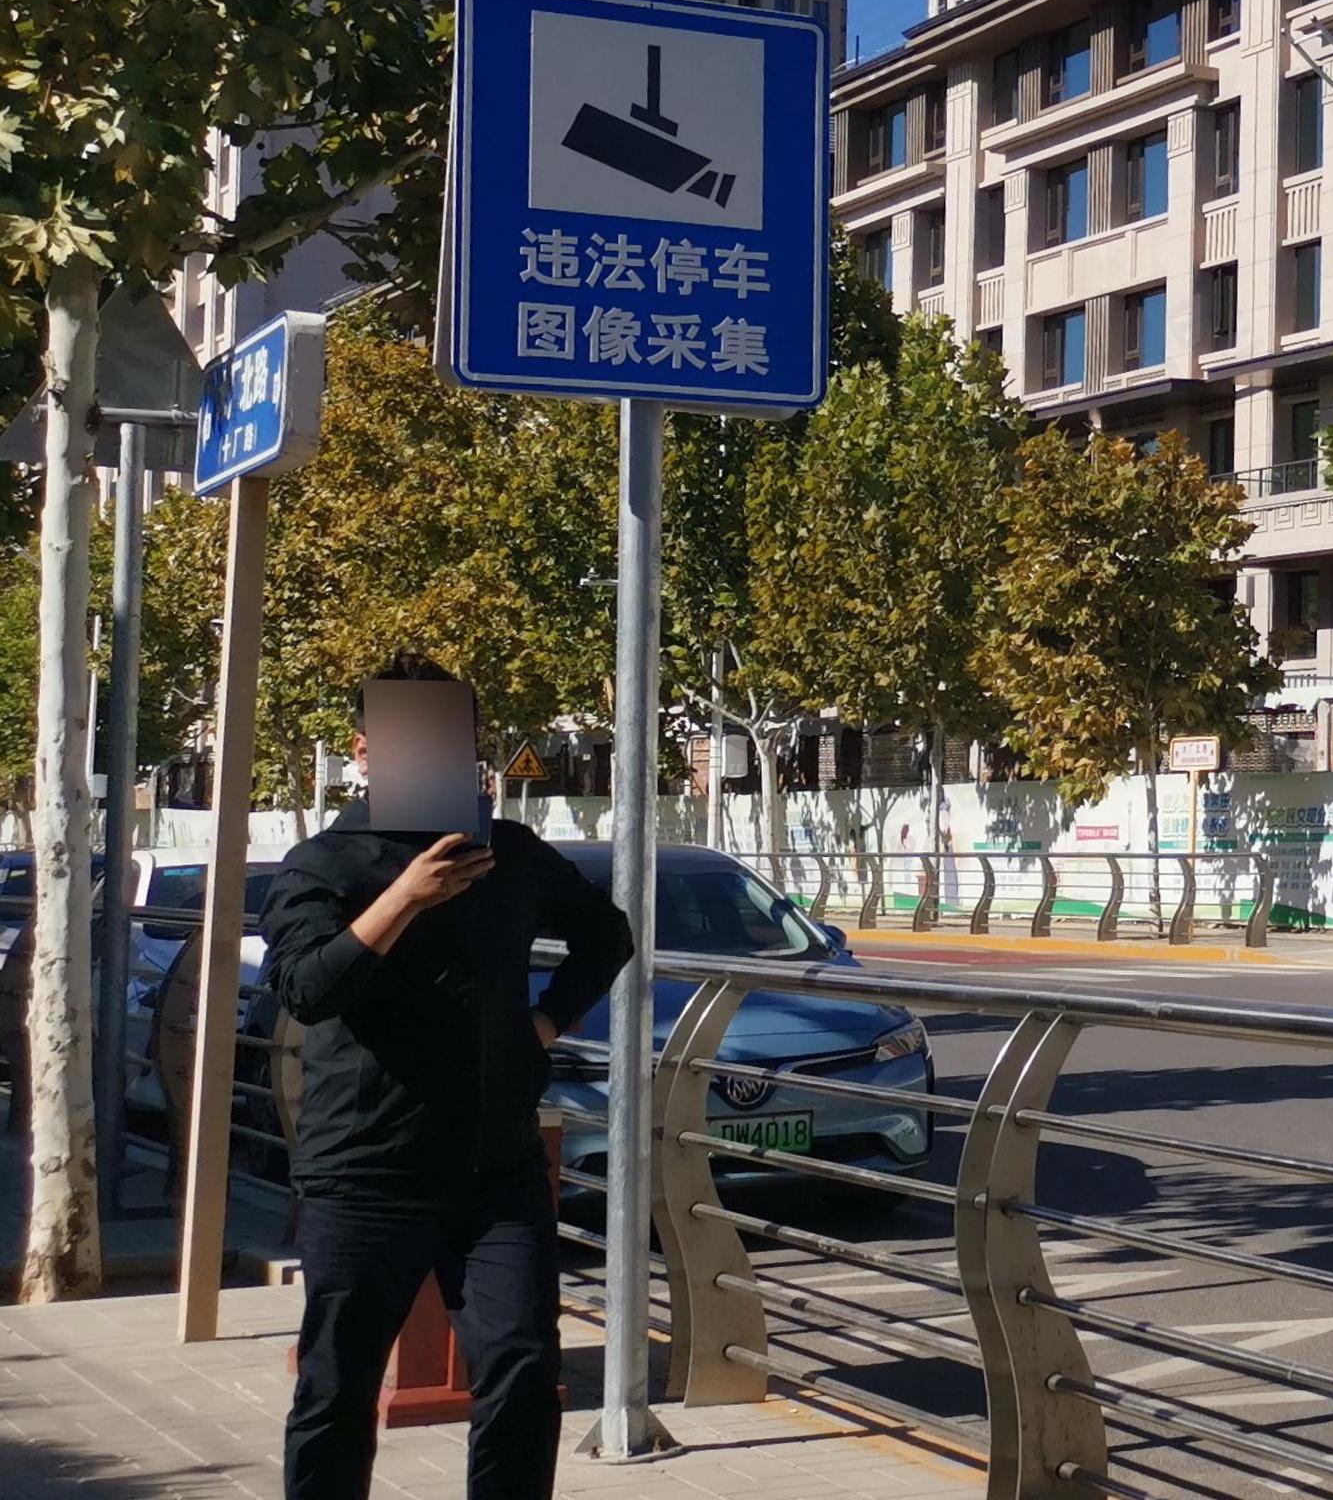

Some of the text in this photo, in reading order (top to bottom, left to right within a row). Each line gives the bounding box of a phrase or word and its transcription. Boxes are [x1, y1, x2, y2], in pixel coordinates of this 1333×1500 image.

[518, 228, 770, 299] 违法停车
[518, 301, 770, 376] 图像采集
